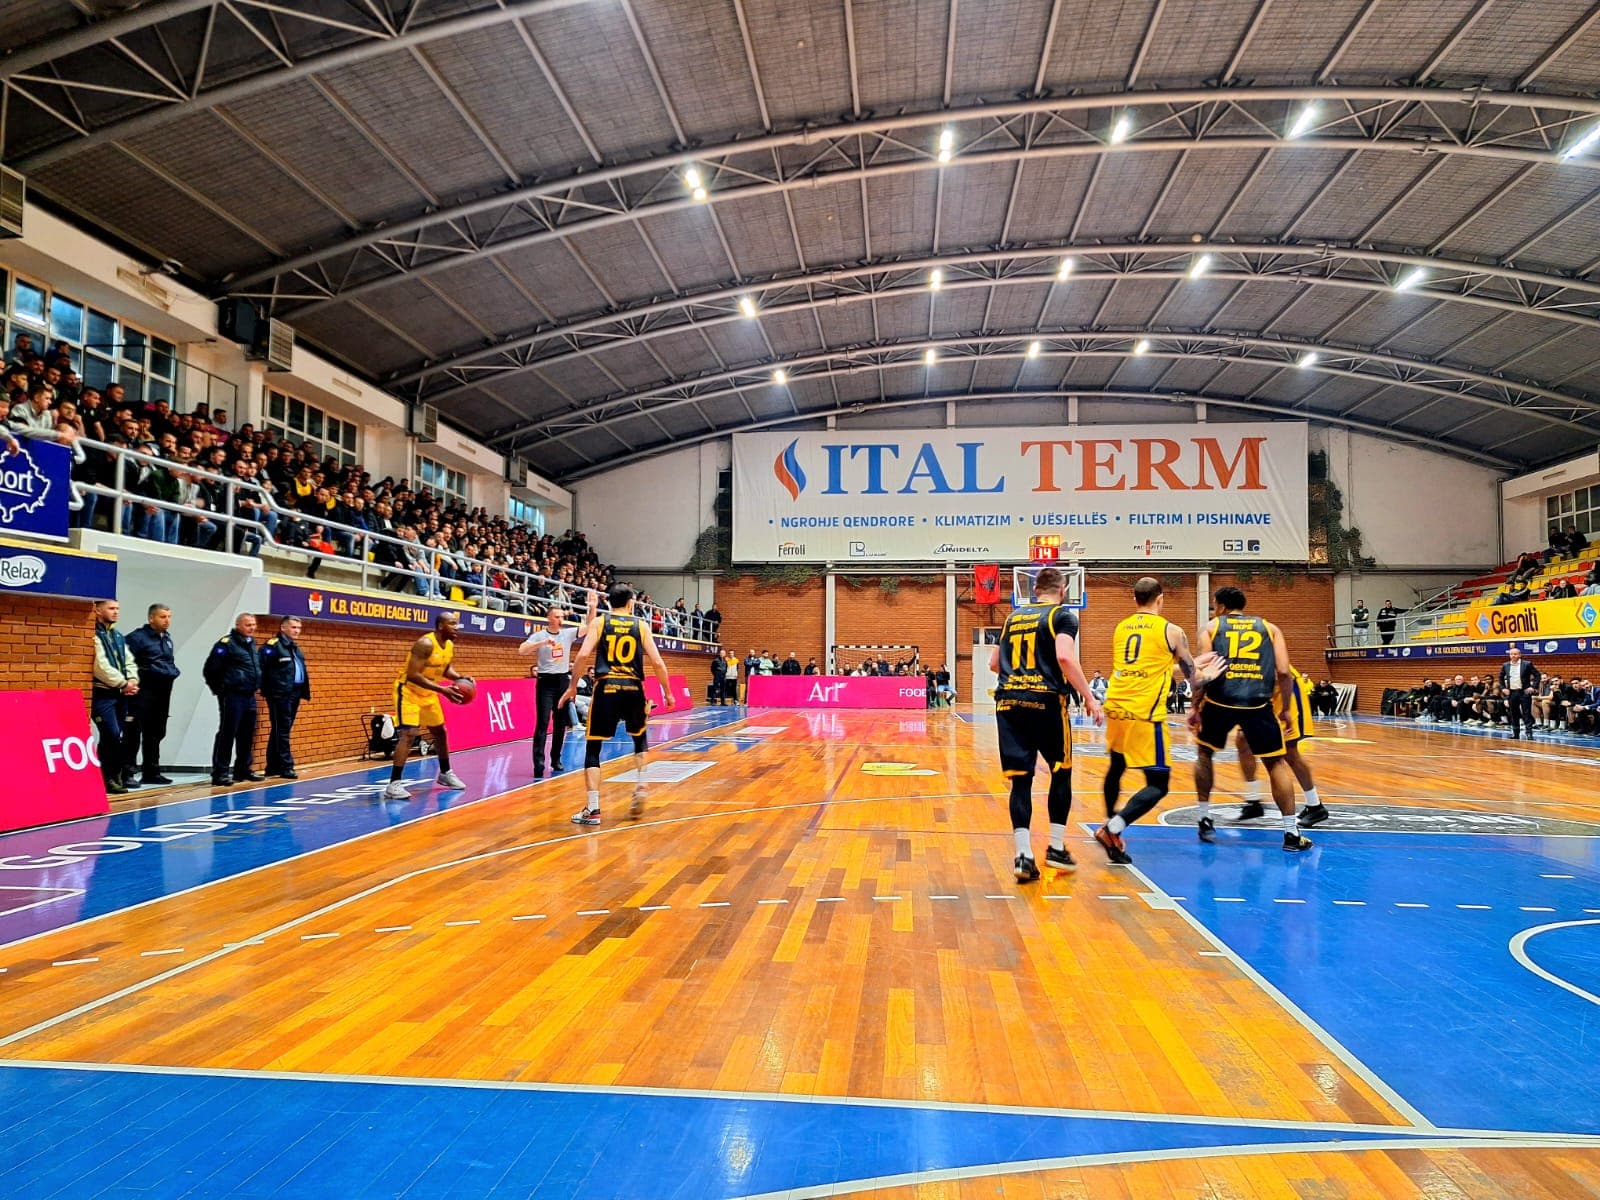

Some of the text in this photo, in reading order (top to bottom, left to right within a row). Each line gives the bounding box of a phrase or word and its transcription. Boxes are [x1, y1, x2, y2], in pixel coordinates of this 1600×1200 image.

[821, 437, 1267, 495] ITAL TERM
[781, 512, 1271, 528] NGROHJE QENDRORE KLIMATIZIM UJËSJELLËS FILTRIM I PISHINAVE
[778, 543, 806, 557] Ferroli
[1, 560, 41, 580] Relax
[330, 598, 349, 614] K.B.
[350, 600, 386, 618] GOLDEN
[386, 605, 412, 621] EAGLE
[1491, 607, 1539, 635] Graniti
[605, 634, 637, 663] 10
[1009, 631, 1037, 671] 11
[1124, 633, 1142, 664] 0
[1225, 630, 1263, 660] 12
[808, 681, 848, 702] Art
[487, 691, 515, 733] Art
